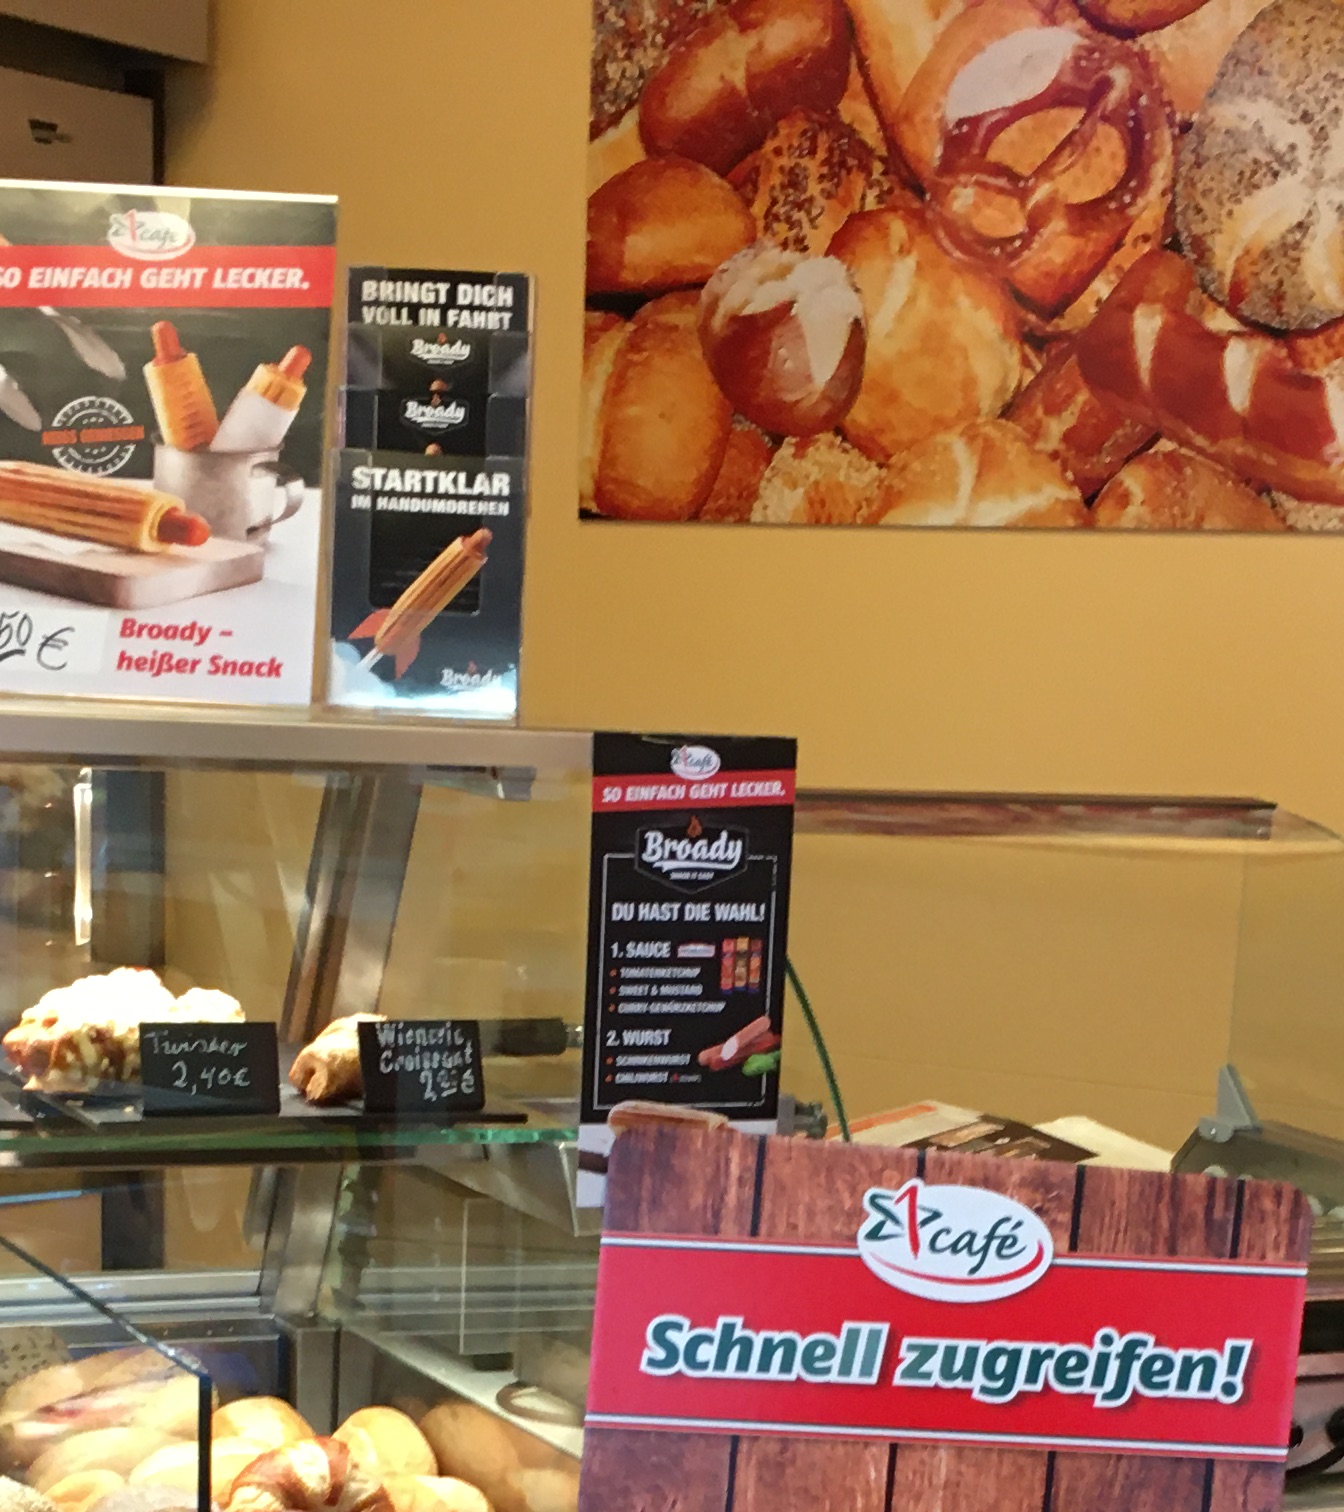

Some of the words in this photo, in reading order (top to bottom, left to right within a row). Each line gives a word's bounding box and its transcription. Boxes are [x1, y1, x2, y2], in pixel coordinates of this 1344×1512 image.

[27, 266, 133, 290] EINFACH
[140, 267, 208, 290] GEHT
[213, 267, 311, 291] LECKER.
[360, 279, 453, 306] BRINGT
[457, 282, 515, 308] DICH
[361, 305, 416, 328] VOLL
[419, 308, 441, 328] IN
[350, 465, 511, 497] STARTKLAR
[119, 617, 211, 644] Broady
[37, 625, 76, 671] €
[116, 650, 202, 678] heißer
[207, 653, 284, 680] Snack
[602, 786, 622, 803] SO
[625, 784, 687, 802] EINFACH
[690, 782, 728, 799] GEHT
[641, 829, 744, 872] Broady
[611, 902, 635, 922] DU
[638, 902, 682, 922] HAST
[683, 902, 712, 922] DIE
[714, 902, 767, 922] WAHL!
[625, 940, 671, 959] SAUCE
[622, 1028, 673, 1047] WURST
[927, 1219, 1026, 1276] café
[640, 1315, 889, 1387] Schnell
[892, 1325, 1255, 1408] zugreifen!
